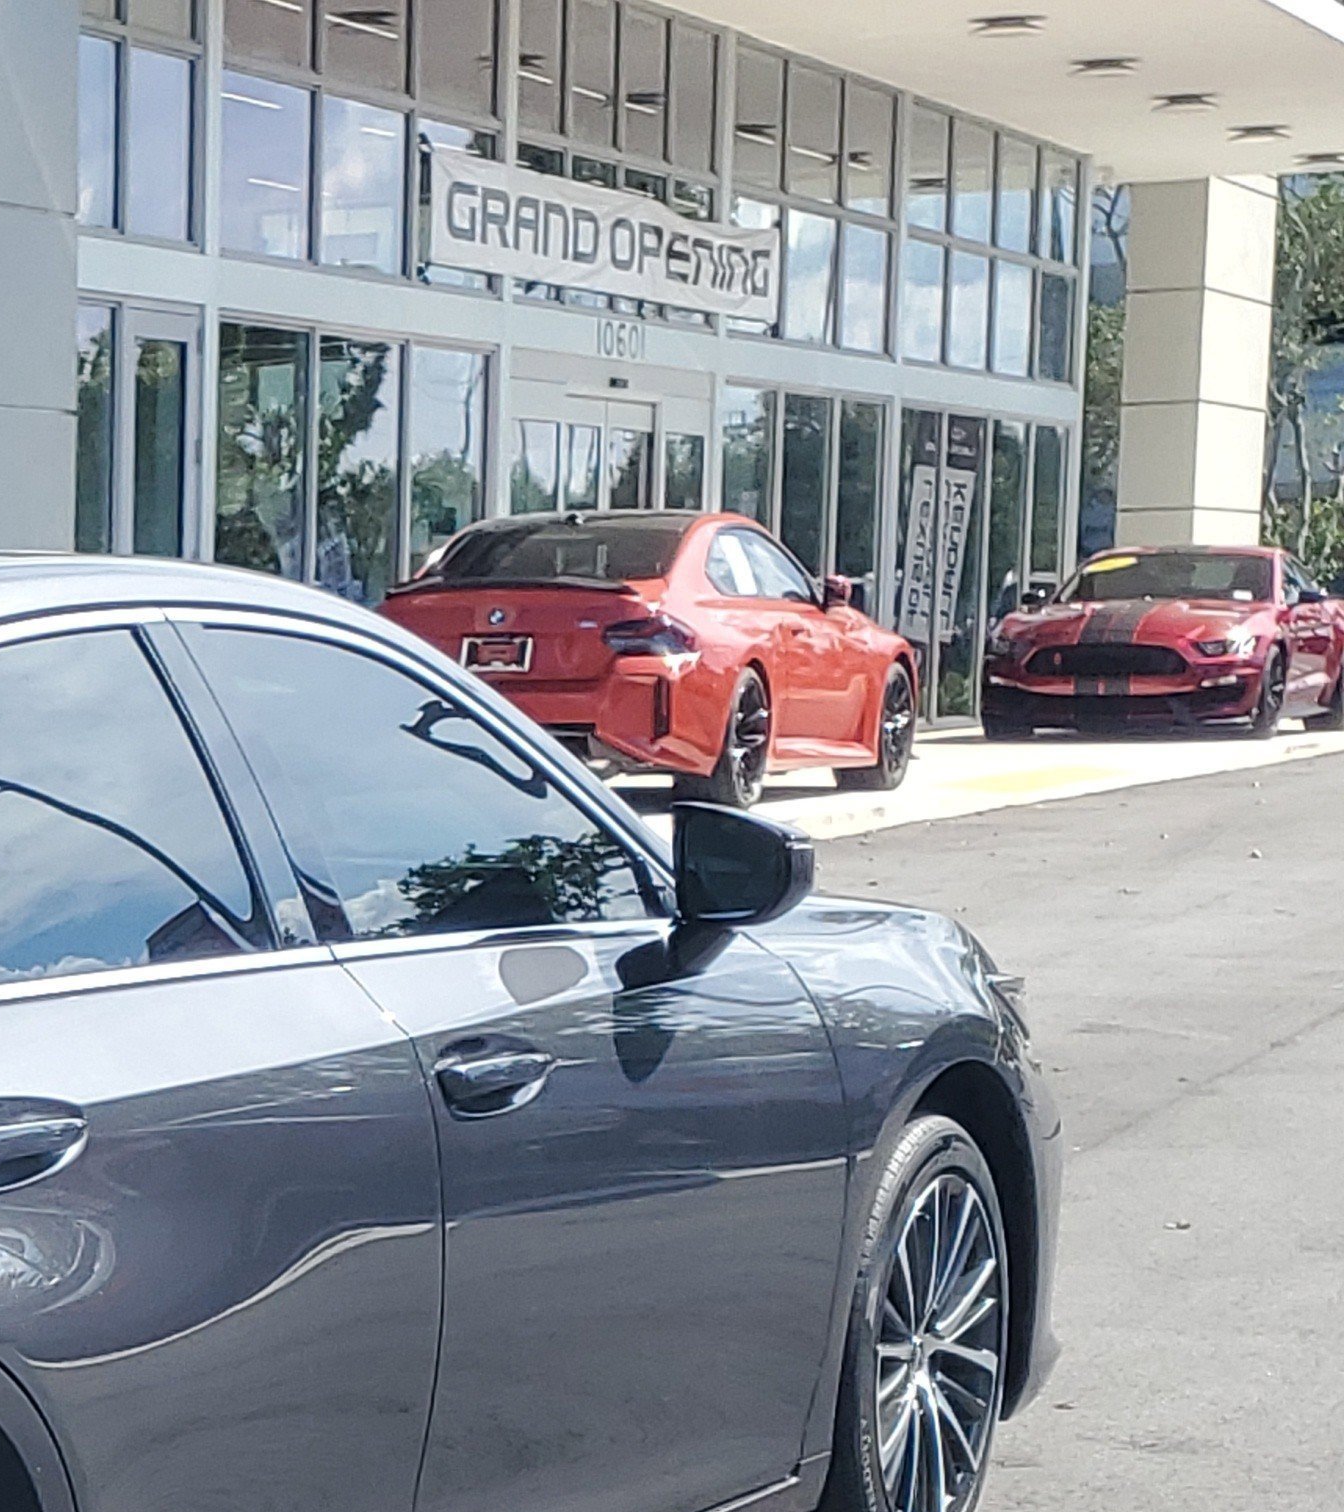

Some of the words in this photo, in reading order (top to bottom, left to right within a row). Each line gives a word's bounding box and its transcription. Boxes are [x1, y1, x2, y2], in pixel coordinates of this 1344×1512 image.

[447, 181, 600, 263] GRAND
[611, 217, 771, 297] OPENING
[597, 318, 645, 359] 10601
